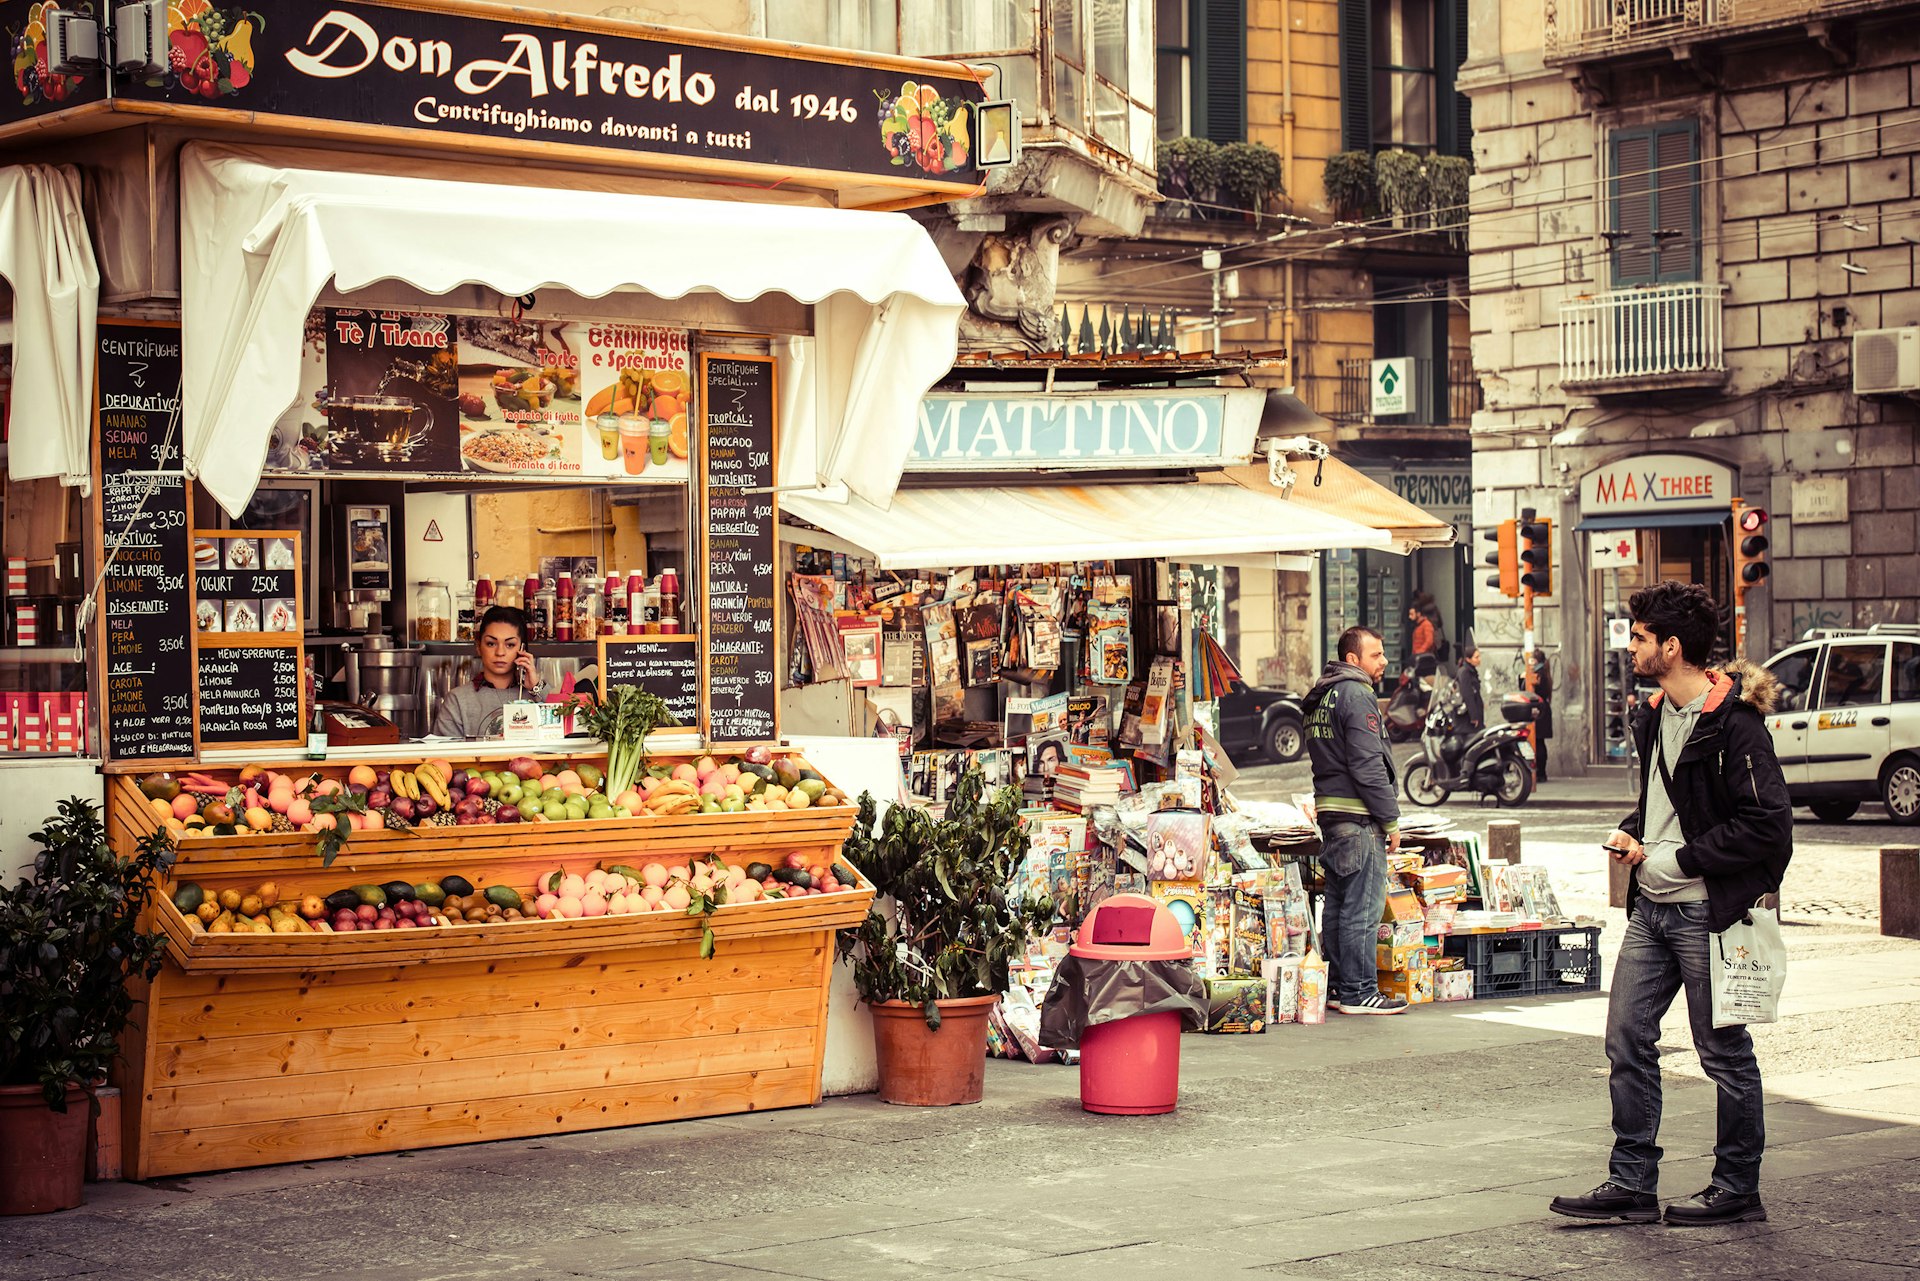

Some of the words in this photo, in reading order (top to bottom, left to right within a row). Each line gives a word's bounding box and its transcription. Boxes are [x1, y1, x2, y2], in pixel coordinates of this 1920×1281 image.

[284, 10, 452, 78] Don
[454, 33, 716, 105] Alfredo
[735, 86, 779, 114] dal
[790, 93, 858, 123] 1946
[414, 96, 593, 133] Centrifughiamo
[601, 117, 678, 143] davanti
[686, 131, 698, 144] a
[707, 129, 751, 150] tutti
[336, 321, 364, 344] Tè
[381, 324, 448, 348] Tisane
[537, 348, 579, 368] Torte
[592, 354, 603, 367] e
[608, 350, 685, 371] Spremute
[106, 414, 147, 428] ANANAS
[502, 409, 541, 423] Tagliata
[543, 410, 552, 421] di
[555, 411, 580, 422] frutta
[709, 427, 738, 435] ANANAS
[911, 399, 1208, 457] MATTINO
[106, 430, 147, 444] SEDANO
[709, 437, 752, 447] AVOCADO
[108, 446, 137, 459] MELA
[710, 448, 736, 459] BANANA
[508, 460, 545, 471] Insalata
[548, 460, 557, 470] di
[559, 461, 581, 471] farro
[711, 460, 742, 470] MANGO
[748, 451, 769, 470] 5,00€
[709, 488, 740, 497] ARANCIA
[1597, 472, 1656, 504] MAX
[1661, 475, 1713, 496] THREE
[710, 499, 728, 507] MELA
[728, 499, 748, 507] ROSSA
[711, 507, 746, 520] PAPAYA
[753, 505, 772, 519] 4,00€
[710, 540, 739, 549] BANANA
[136, 565, 165, 577] VERDE
[711, 562, 735, 575] PERA
[753, 564, 772, 576] 4,50€
[107, 578, 144, 592] LIMONE
[157, 574, 184, 592] 3,50€
[251, 576, 280, 593] 2,50€
[712, 612, 730, 622] MELA
[732, 612, 752, 622] VERDE
[111, 620, 133, 629] MELA
[712, 624, 744, 634] ZENZERO
[112, 631, 134, 642] PERA
[884, 632, 900, 640] THE
[901, 631, 922, 640] JUDGE
[112, 643, 143, 655] LIMONE
[159, 635, 184, 652] 3,50€
[710, 655, 739, 665] CAROTA
[199, 662, 239, 674] ARANCIA
[711, 667, 738, 676] SEDANO
[110, 677, 143, 689] CAROTA
[199, 676, 232, 686] LIMONE
[711, 677, 728, 685] MELA
[112, 690, 143, 702] LIMONE
[200, 690, 221, 700] MELA
[223, 689, 260, 699] ANNURCA
[711, 686, 735, 694] ZENZERO
[112, 702, 147, 714] ARANCIA
[163, 693, 189, 711] 3,50€
[200, 703, 239, 716] POMPELMO
[276, 702, 297, 714] 3,00€
[1068, 703, 1091, 711] CALCIO
[123, 718, 146, 728] ALOE
[201, 720, 240, 732] ARANCIA
[243, 721, 268, 730] ROSSA
[275, 717, 298, 729] 3,00€
[720, 726, 738, 736] ALOE
[1724, 958, 1747, 970] STAR
